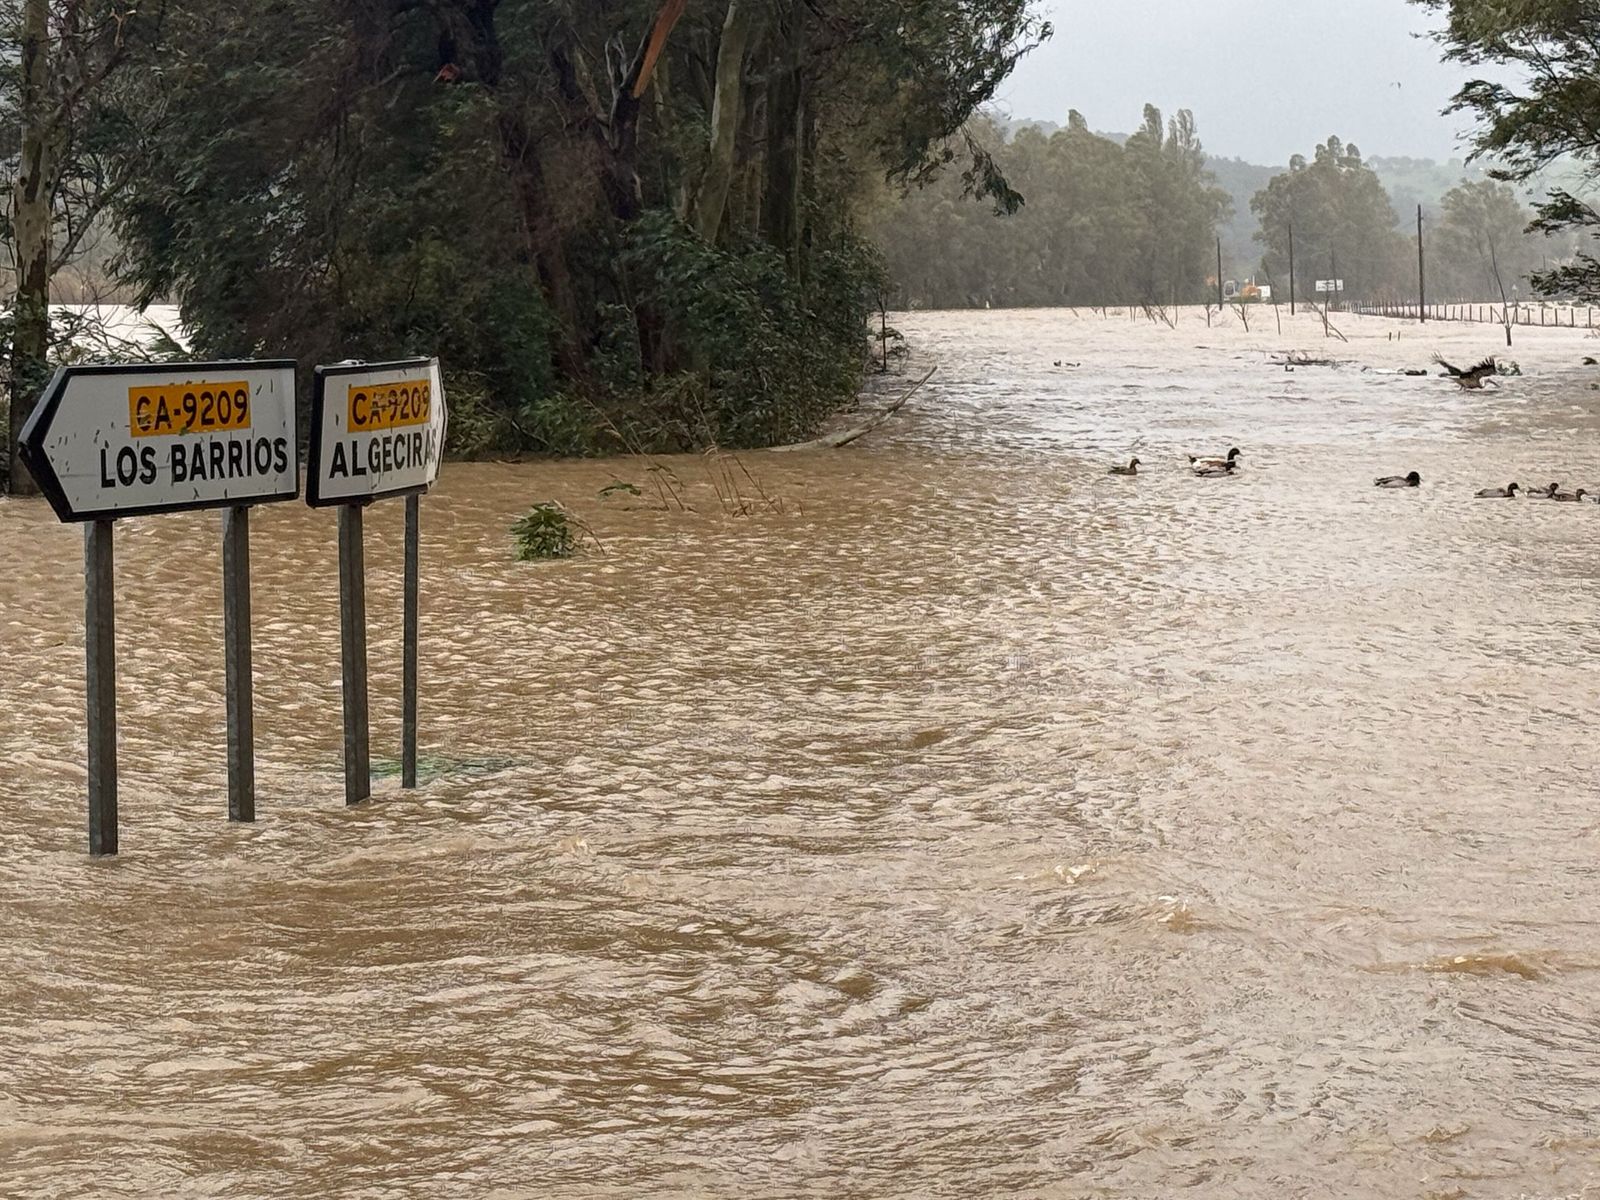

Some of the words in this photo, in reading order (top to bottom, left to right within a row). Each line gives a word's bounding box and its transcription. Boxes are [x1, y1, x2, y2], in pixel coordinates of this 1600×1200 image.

[136, 387, 249, 432] CA-9209
[352, 385, 430, 425] CA-9209
[100, 446, 156, 489] LOS
[171, 437, 288, 482] BARRIOS
